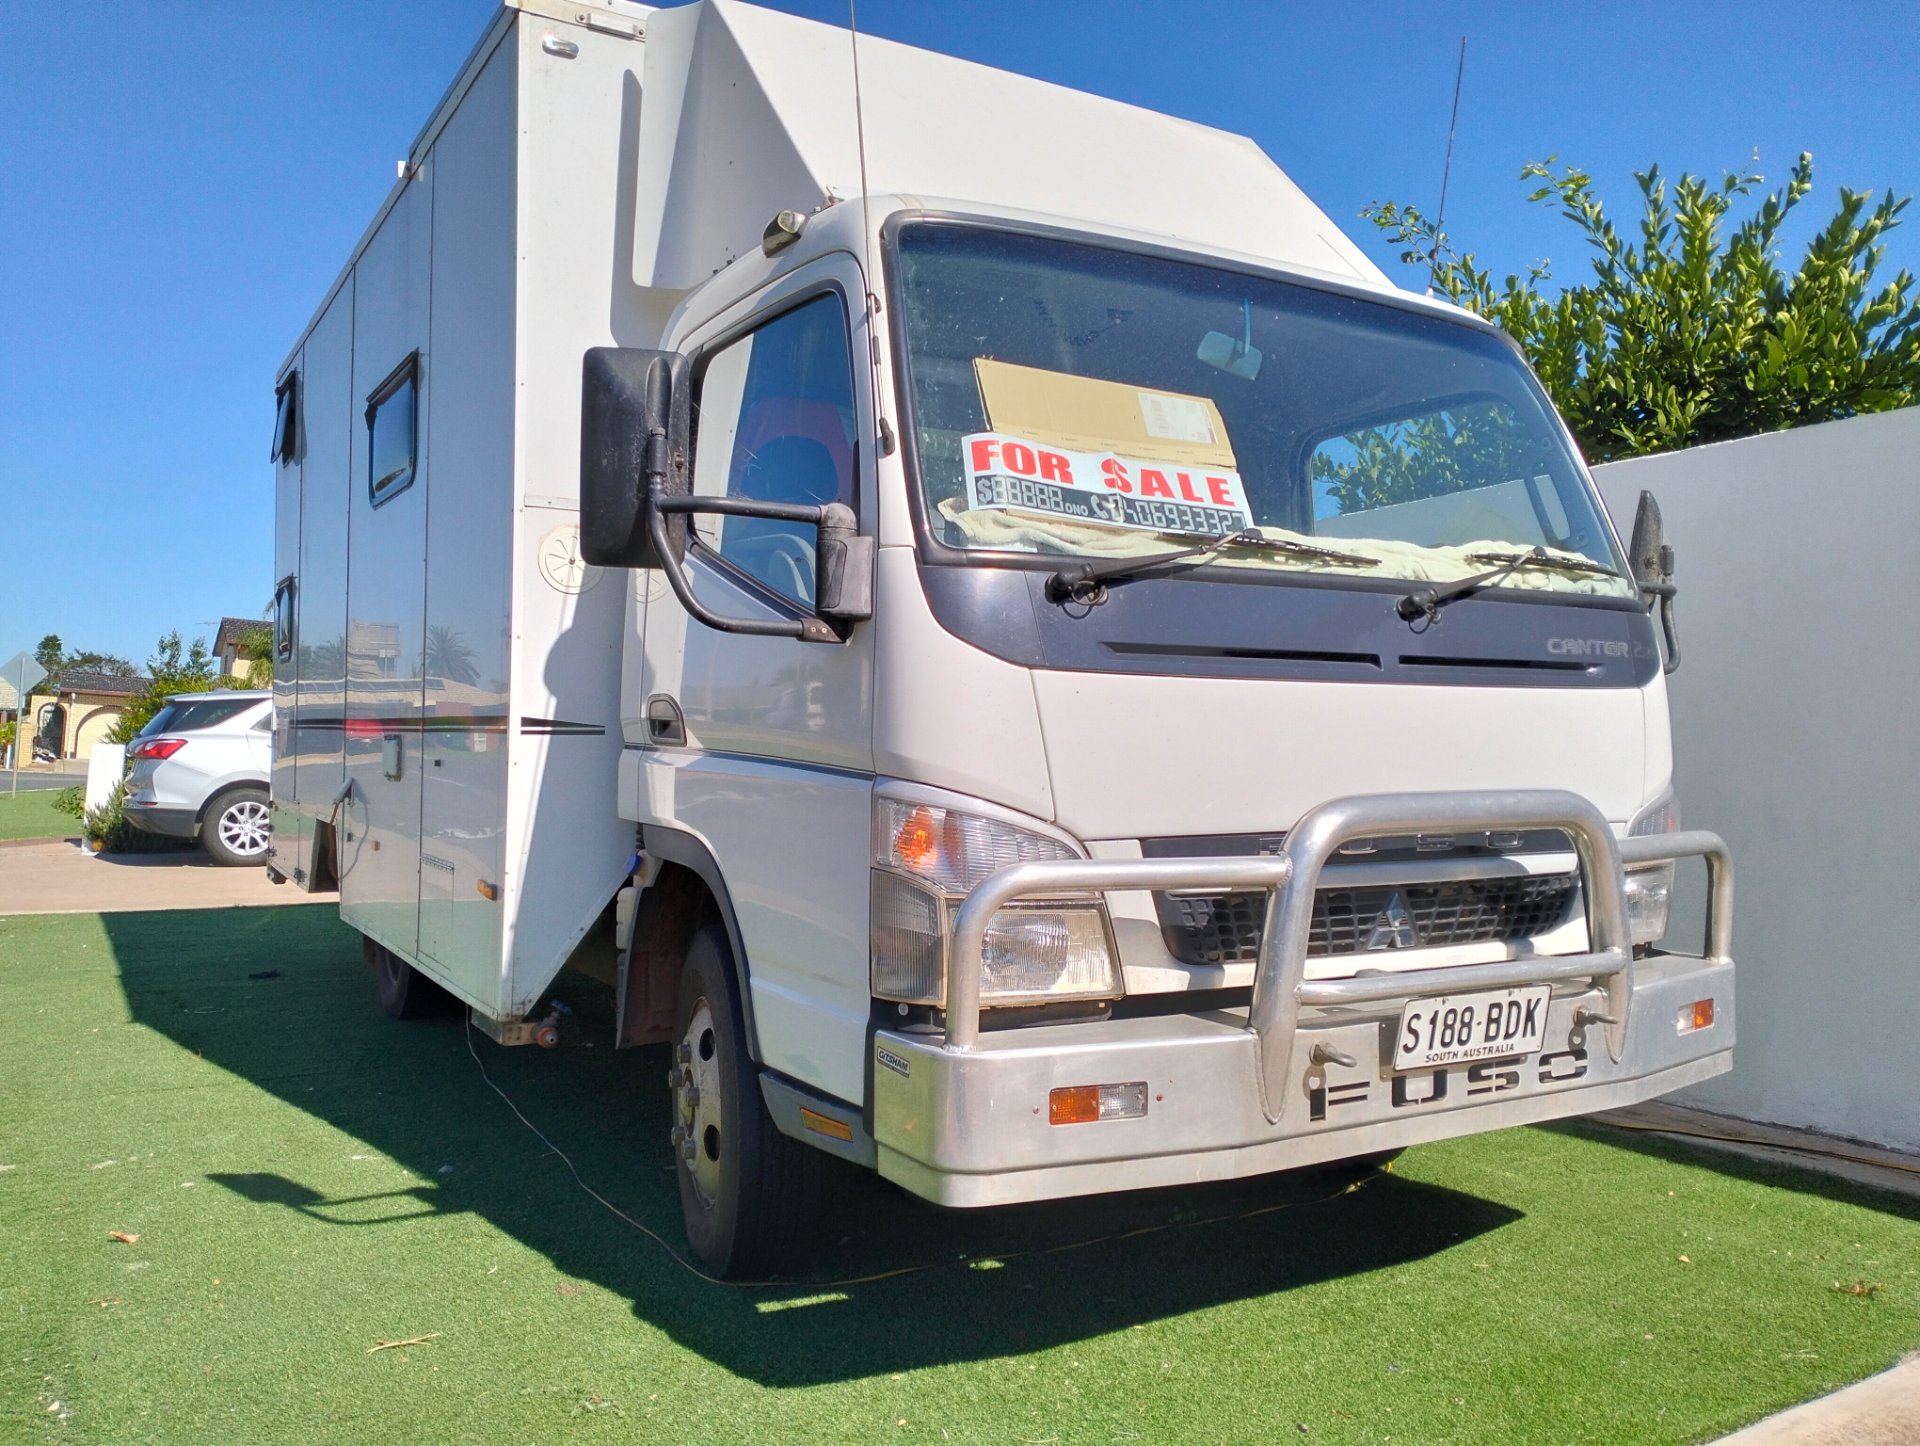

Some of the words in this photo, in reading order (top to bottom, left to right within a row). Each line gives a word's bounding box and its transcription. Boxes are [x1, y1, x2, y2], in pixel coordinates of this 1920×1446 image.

[971, 439, 1074, 485] FOR
[1100, 458, 1236, 507] SALE
[1065, 502, 1089, 516] ONO
[1546, 637, 1629, 658] CANTER
[1425, 1052, 1460, 1064] SOUTH
[1462, 1044, 1515, 1058] AUSTRALIA
